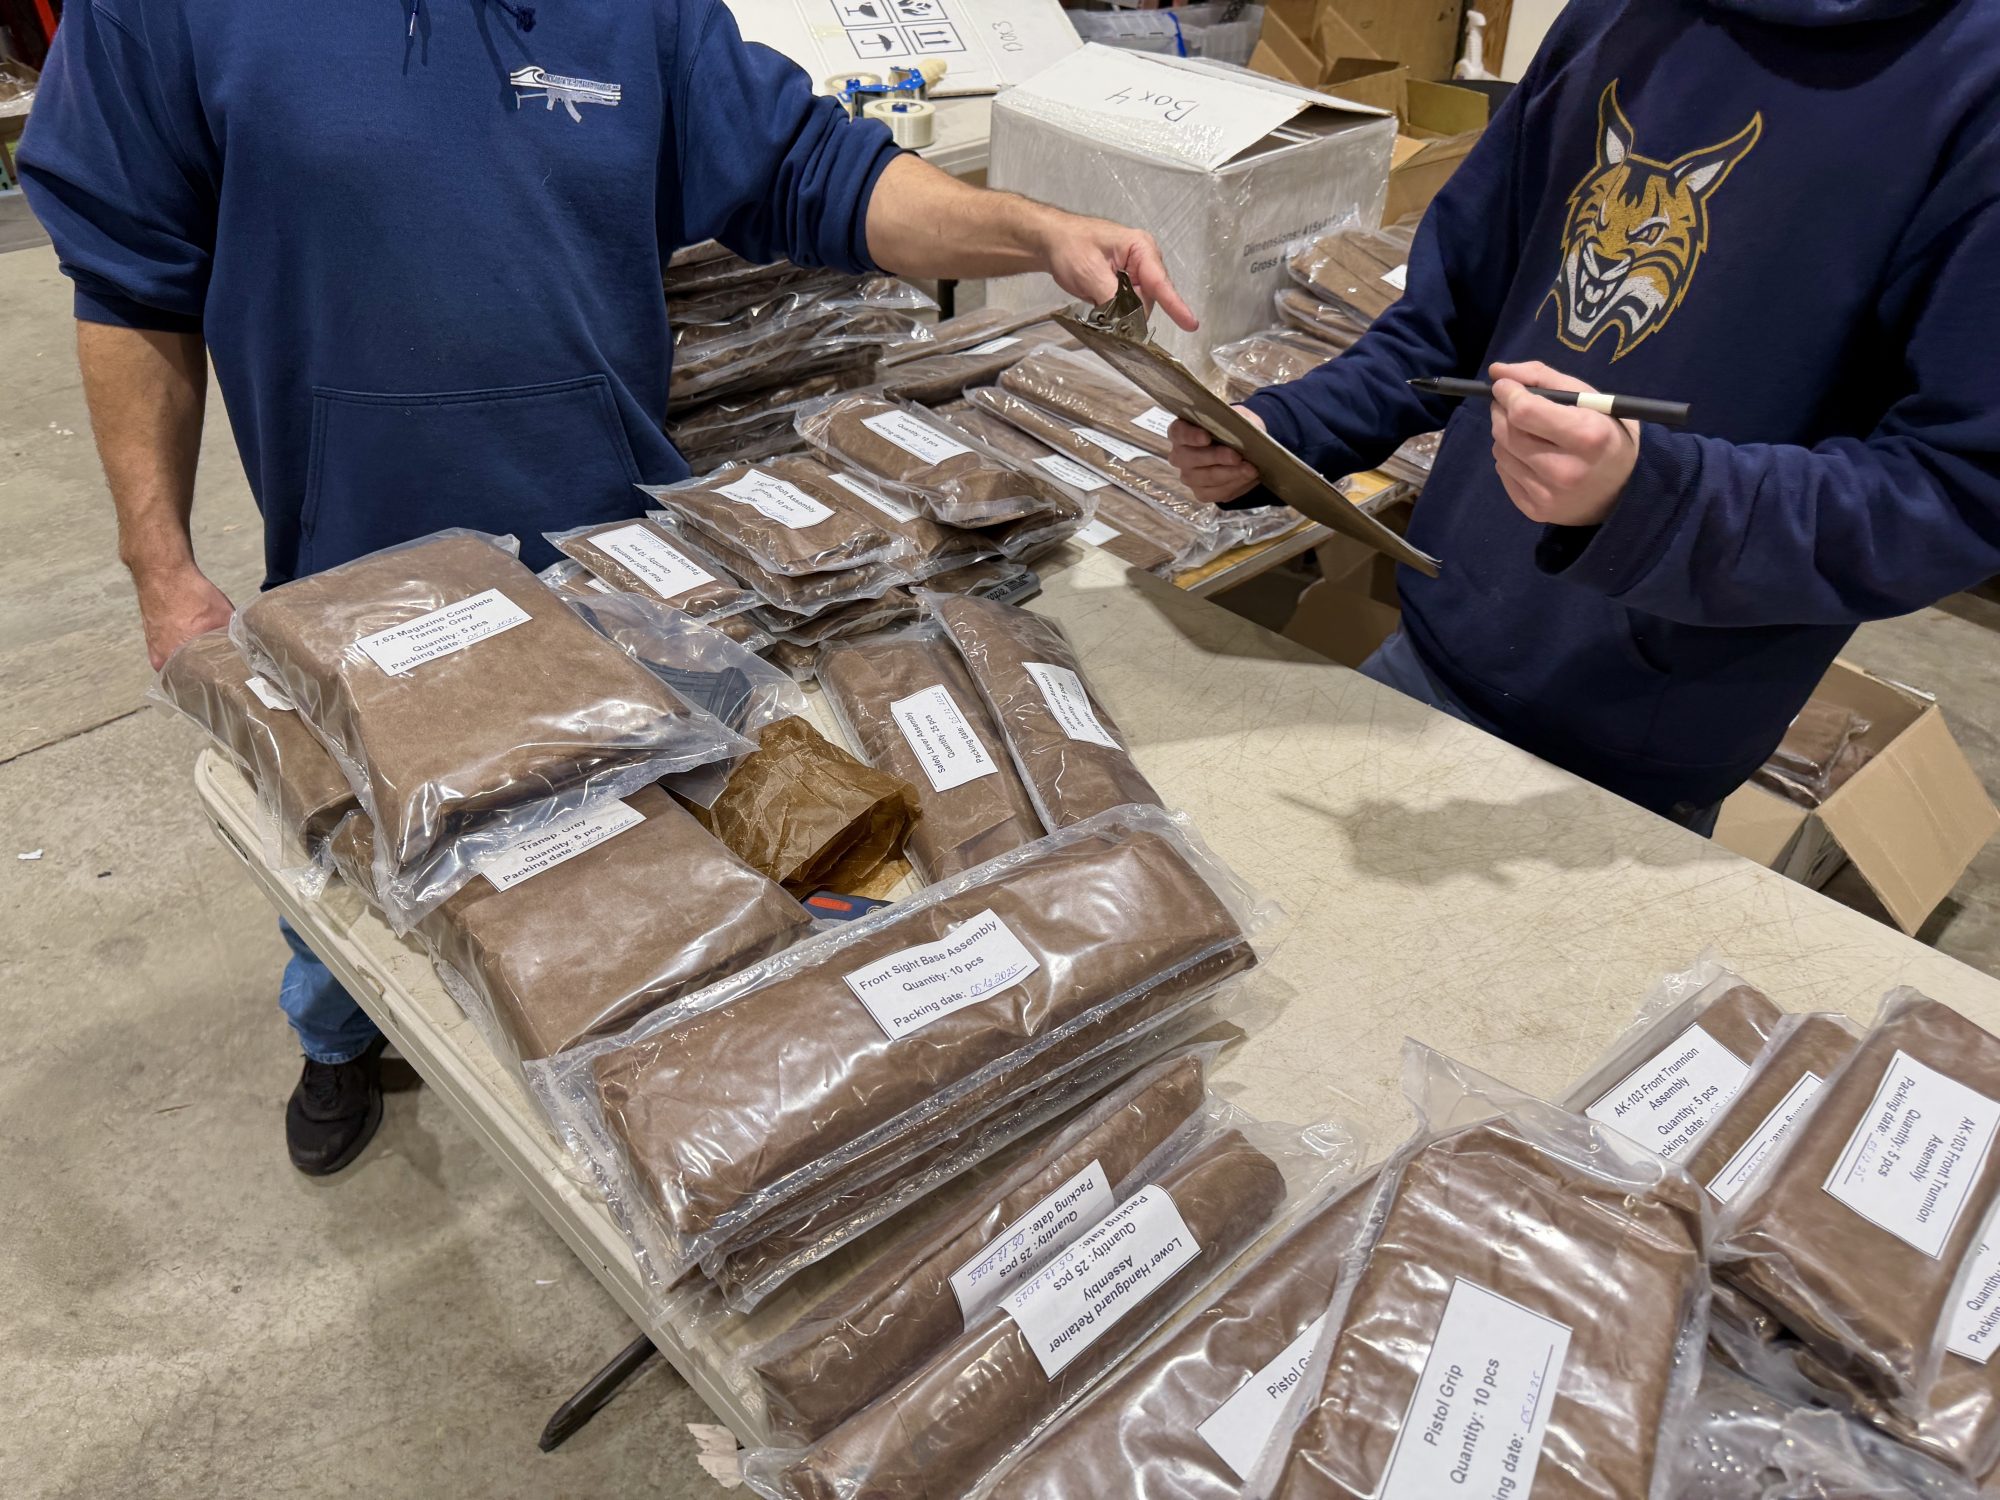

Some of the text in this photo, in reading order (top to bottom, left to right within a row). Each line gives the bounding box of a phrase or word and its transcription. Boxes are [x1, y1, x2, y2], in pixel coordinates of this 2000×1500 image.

[1105, 87, 1200, 122] Box 4
[1250, 256, 1278, 274] Gross
[787, 494, 816, 513] Assembly
[610, 544, 636, 565] Assembly
[678, 558, 701, 576] Packing
[373, 597, 494, 647] 7.62 Magazine Complete
[407, 611, 474, 642] Transp. Grey
[412, 619, 490, 653] Quantity: 5 pcs
[391, 648, 435, 670] Packing
[436, 639, 463, 653] date:
[1057, 681, 1068, 695] pcs
[925, 714, 936, 727] pcs
[956, 724, 969, 740] date:
[904, 711, 946, 774] Safety Lever Assembly
[937, 732, 956, 759] Quantity:
[965, 737, 984, 764] Packing
[524, 838, 574, 865] Quantity:
[583, 824, 603, 838] pcs
[502, 859, 549, 882] Packing
[549, 846, 577, 861] date:
[858, 919, 998, 991] Front Sight Base Assembly
[902, 955, 984, 993] Quantity: 10 pcs
[893, 1000, 941, 1028] Packing
[940, 989, 967, 1006] date:
[1613, 1046, 1700, 1118] AK-103 Front Trunnion
[1648, 1076, 1690, 1111] Assembly
[1885, 1076, 1916, 1113] Packing
[1657, 1103, 1698, 1135] Quantity:
[1692, 1096, 1704, 1105] 5
[1701, 1085, 1719, 1102] pcs
[1875, 1111, 1895, 1137] date:
[1658, 1116, 1708, 1159] cking date:
[1878, 1109, 1921, 1178] Quantity: 5 pcs
[1909, 1134, 1944, 1182] Assembly
[1916, 1116, 1976, 1224] AK-103 Front Trunnion
[1053, 1177, 1094, 1214] Packing
[1104, 1195, 1149, 1227] Packing
[1030, 1211, 1055, 1235] date:
[1033, 1210, 1078, 1250] Quantity:
[1078, 1226, 1107, 1250] date:
[1020, 1247, 1034, 1263] 25
[1088, 1221, 1137, 1262] Quantity:
[999, 1256, 1018, 1278] pcs
[1053, 1269, 1074, 1291] pcs
[1074, 1259, 1090, 1276] 25
[1082, 1255, 1134, 1302] Assembly
[1050, 1237, 1183, 1353] Lower Handguard Retainer
[1266, 1366, 1302, 1399] Pistol
[1423, 1364, 1465, 1447] Pistol Grip
[1450, 1358, 1500, 1485] Quantity: 10 pcs
[1502, 1432, 1525, 1473] date:
